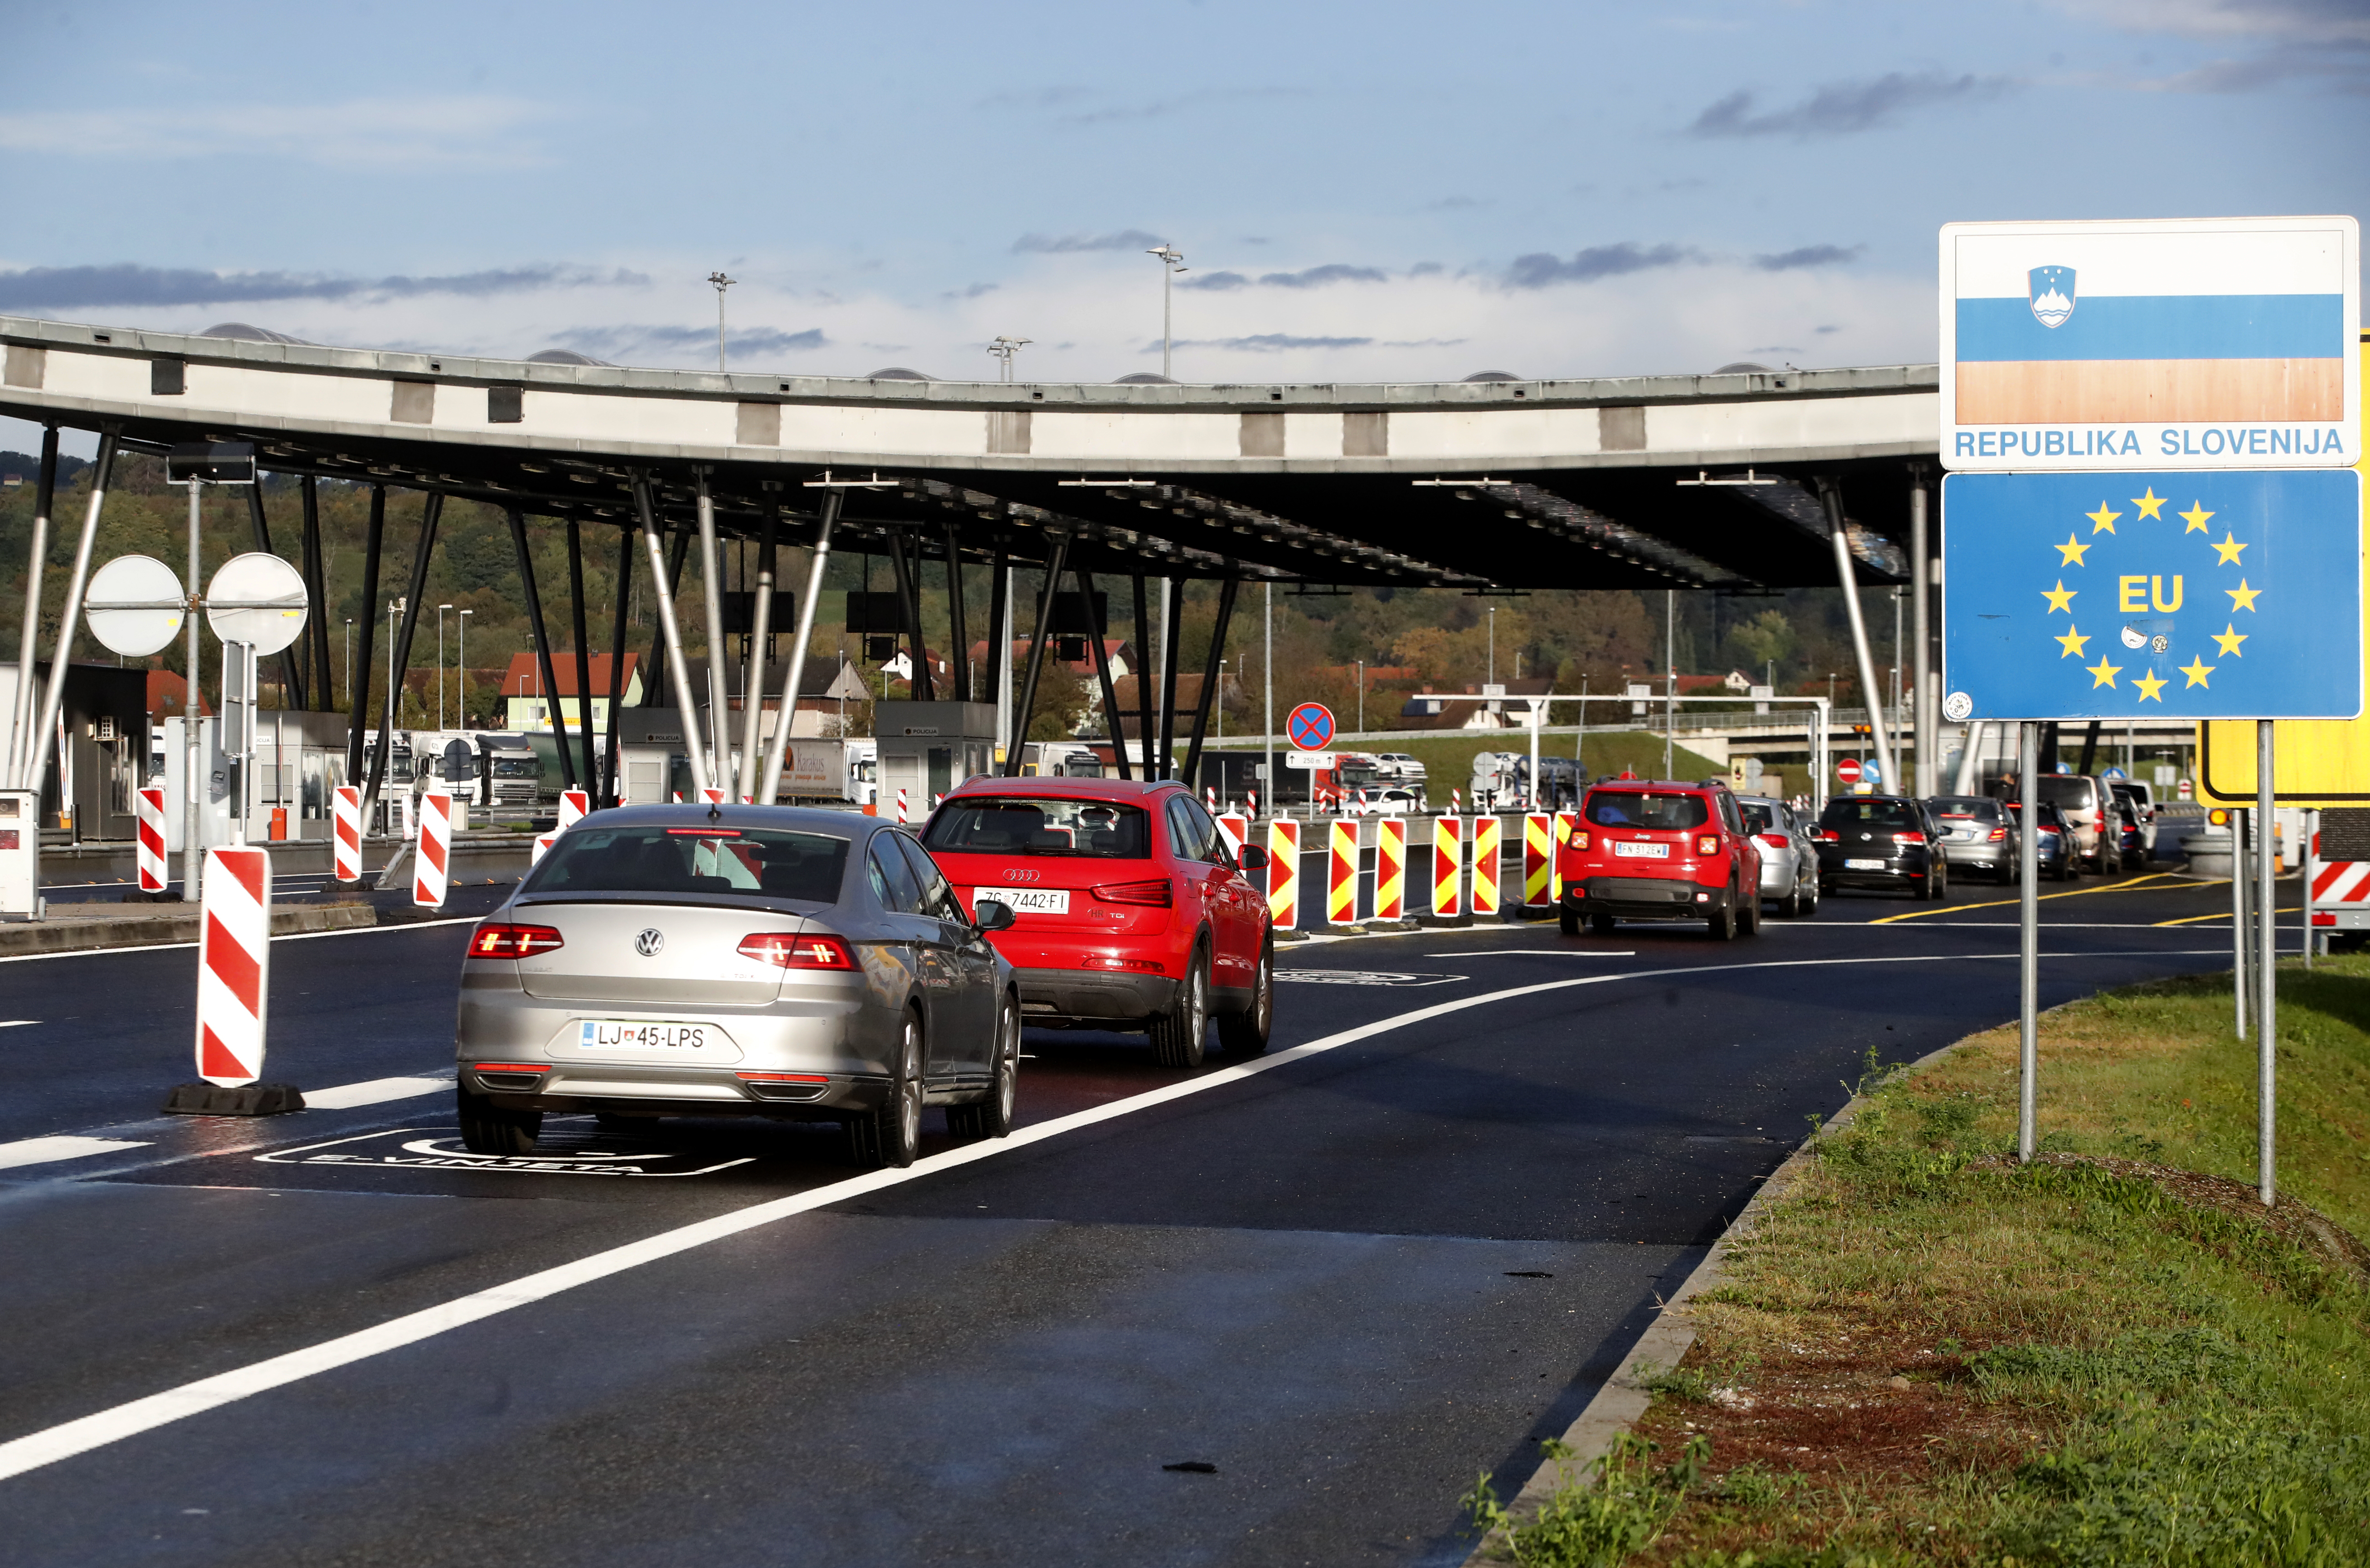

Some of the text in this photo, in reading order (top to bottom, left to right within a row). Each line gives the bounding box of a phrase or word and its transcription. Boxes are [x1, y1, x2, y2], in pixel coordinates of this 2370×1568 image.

[1956, 429, 2344, 456] REPUBLIKA SLOVENIJA
[2120, 575, 2183, 612] EU
[797, 747, 824, 772] Karakus
[1091, 909, 1104, 917] HR
[599, 1026, 704, 1048] LJ 45-LPS
[307, 1155, 644, 1172] E-VINJETA
